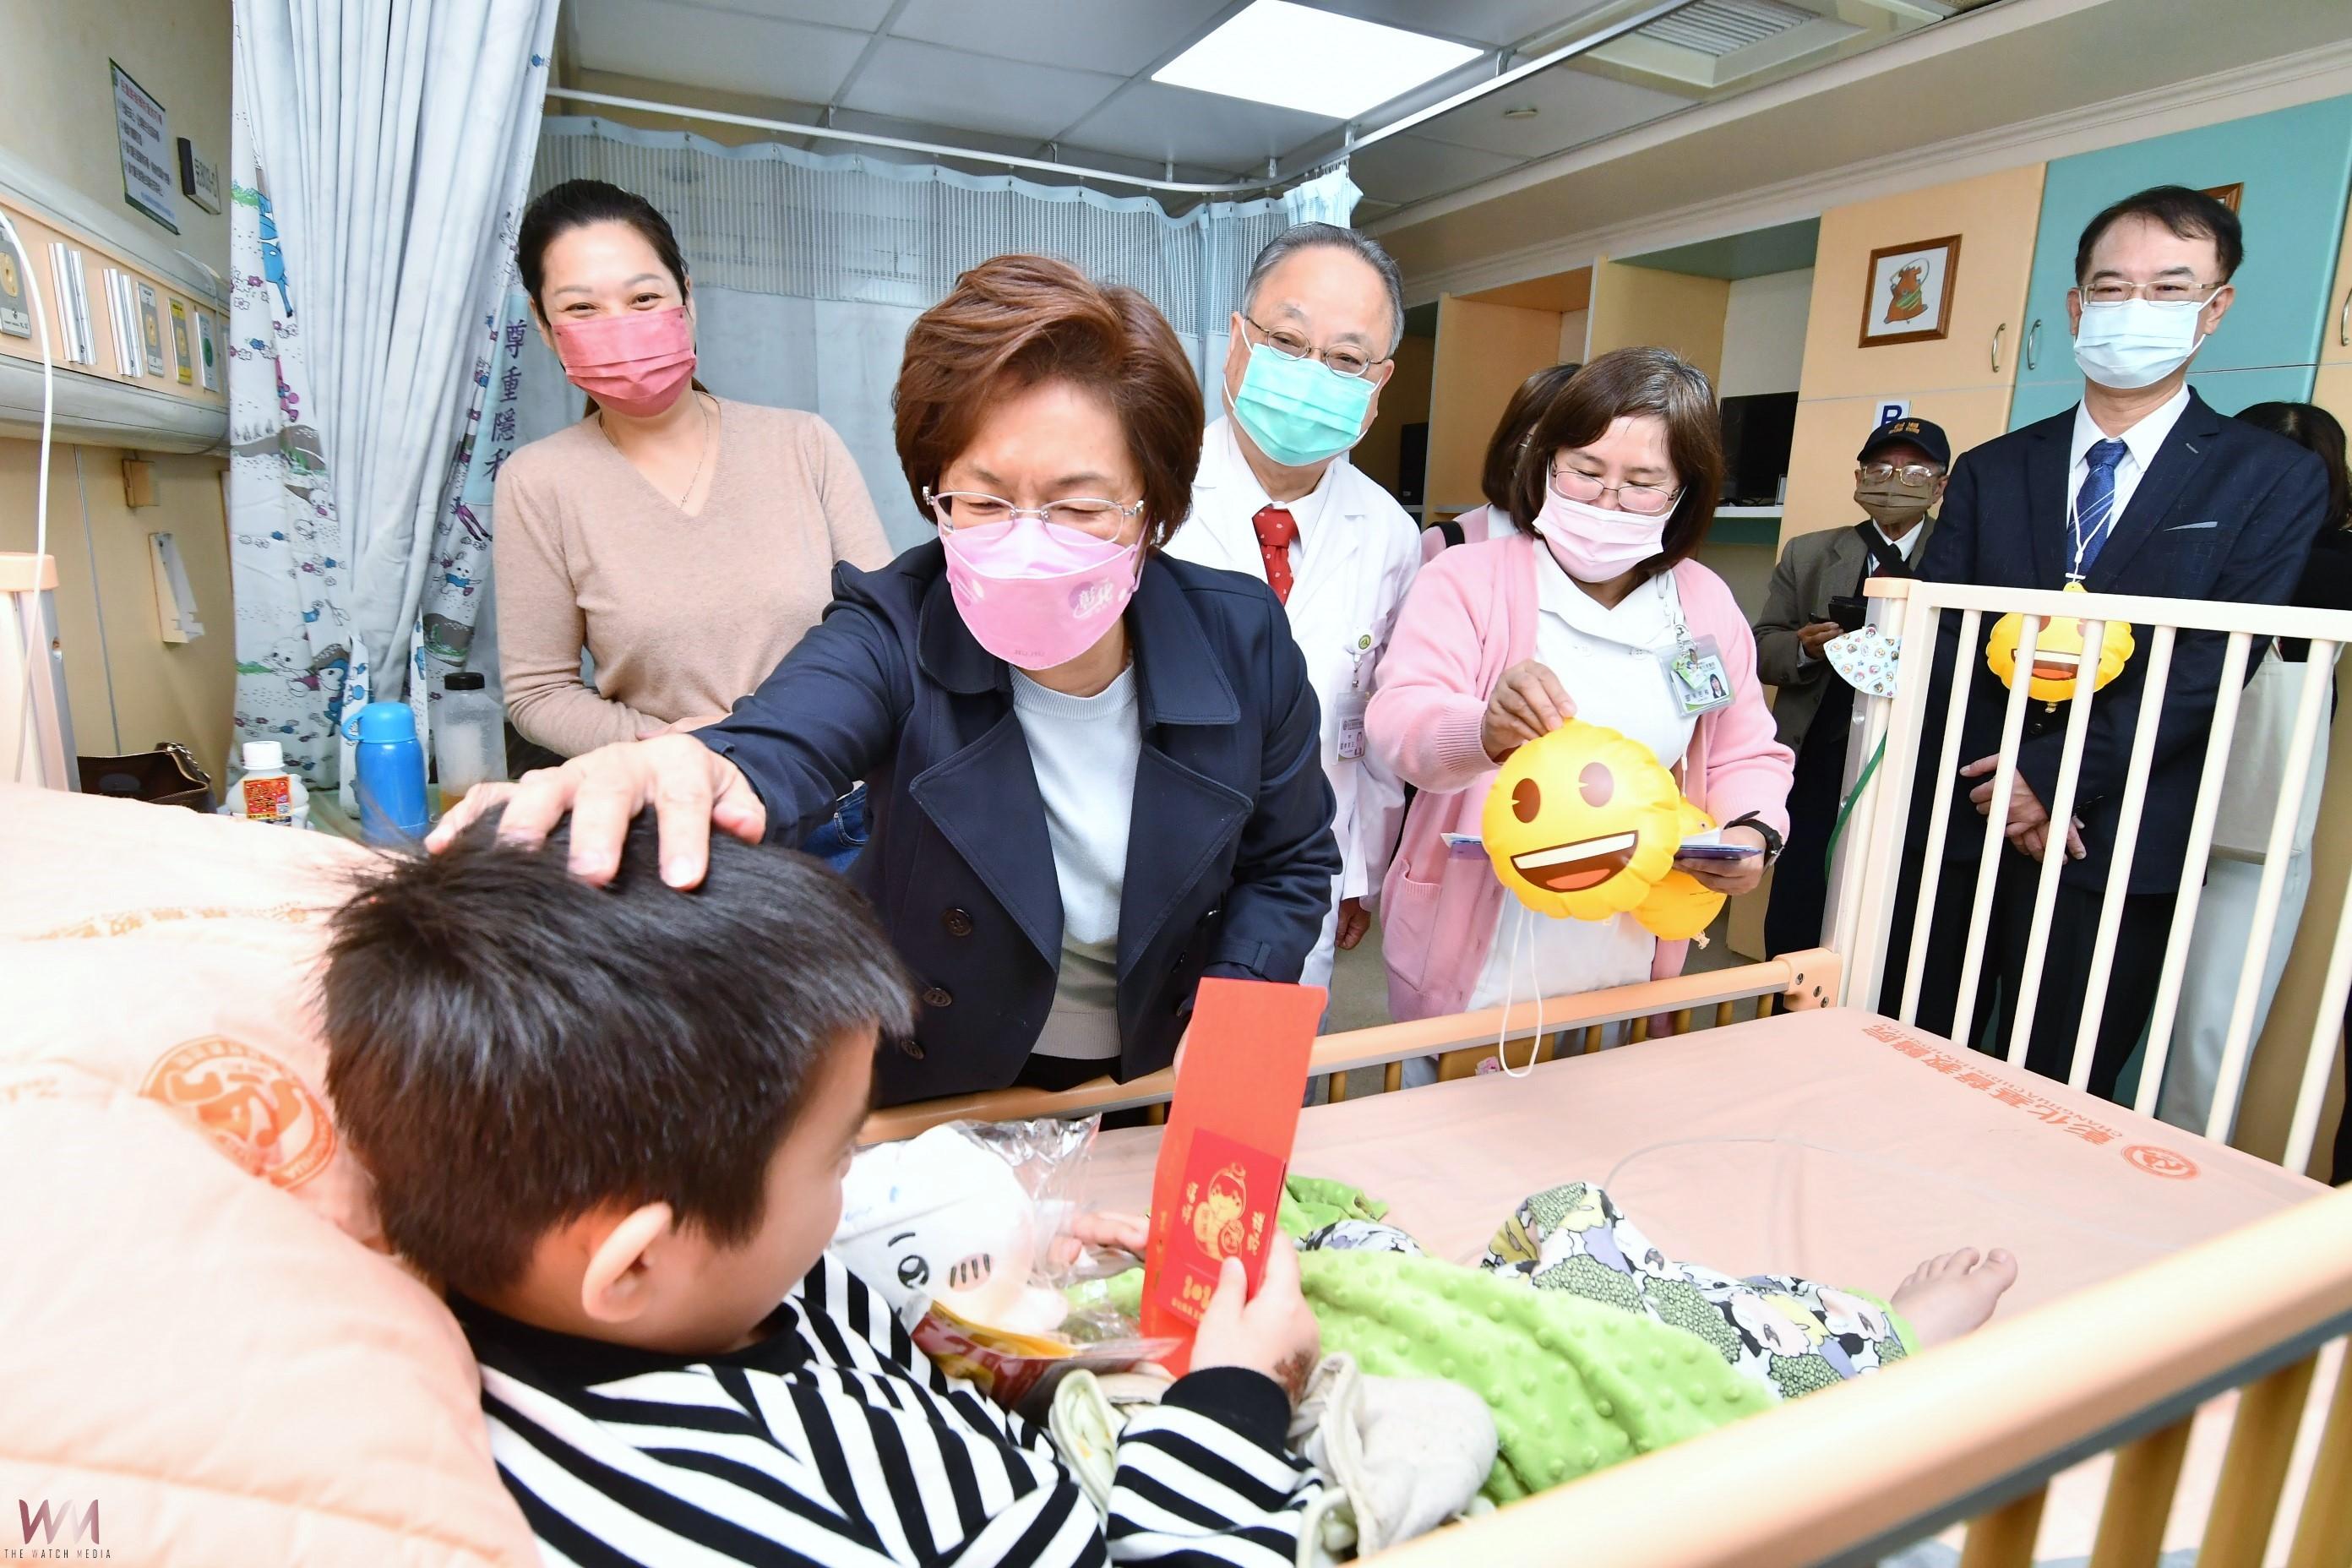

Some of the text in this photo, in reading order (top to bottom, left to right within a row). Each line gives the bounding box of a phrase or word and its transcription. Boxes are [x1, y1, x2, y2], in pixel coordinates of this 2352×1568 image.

[1861, 1025, 2115, 1146] 彰化基督教醫院
